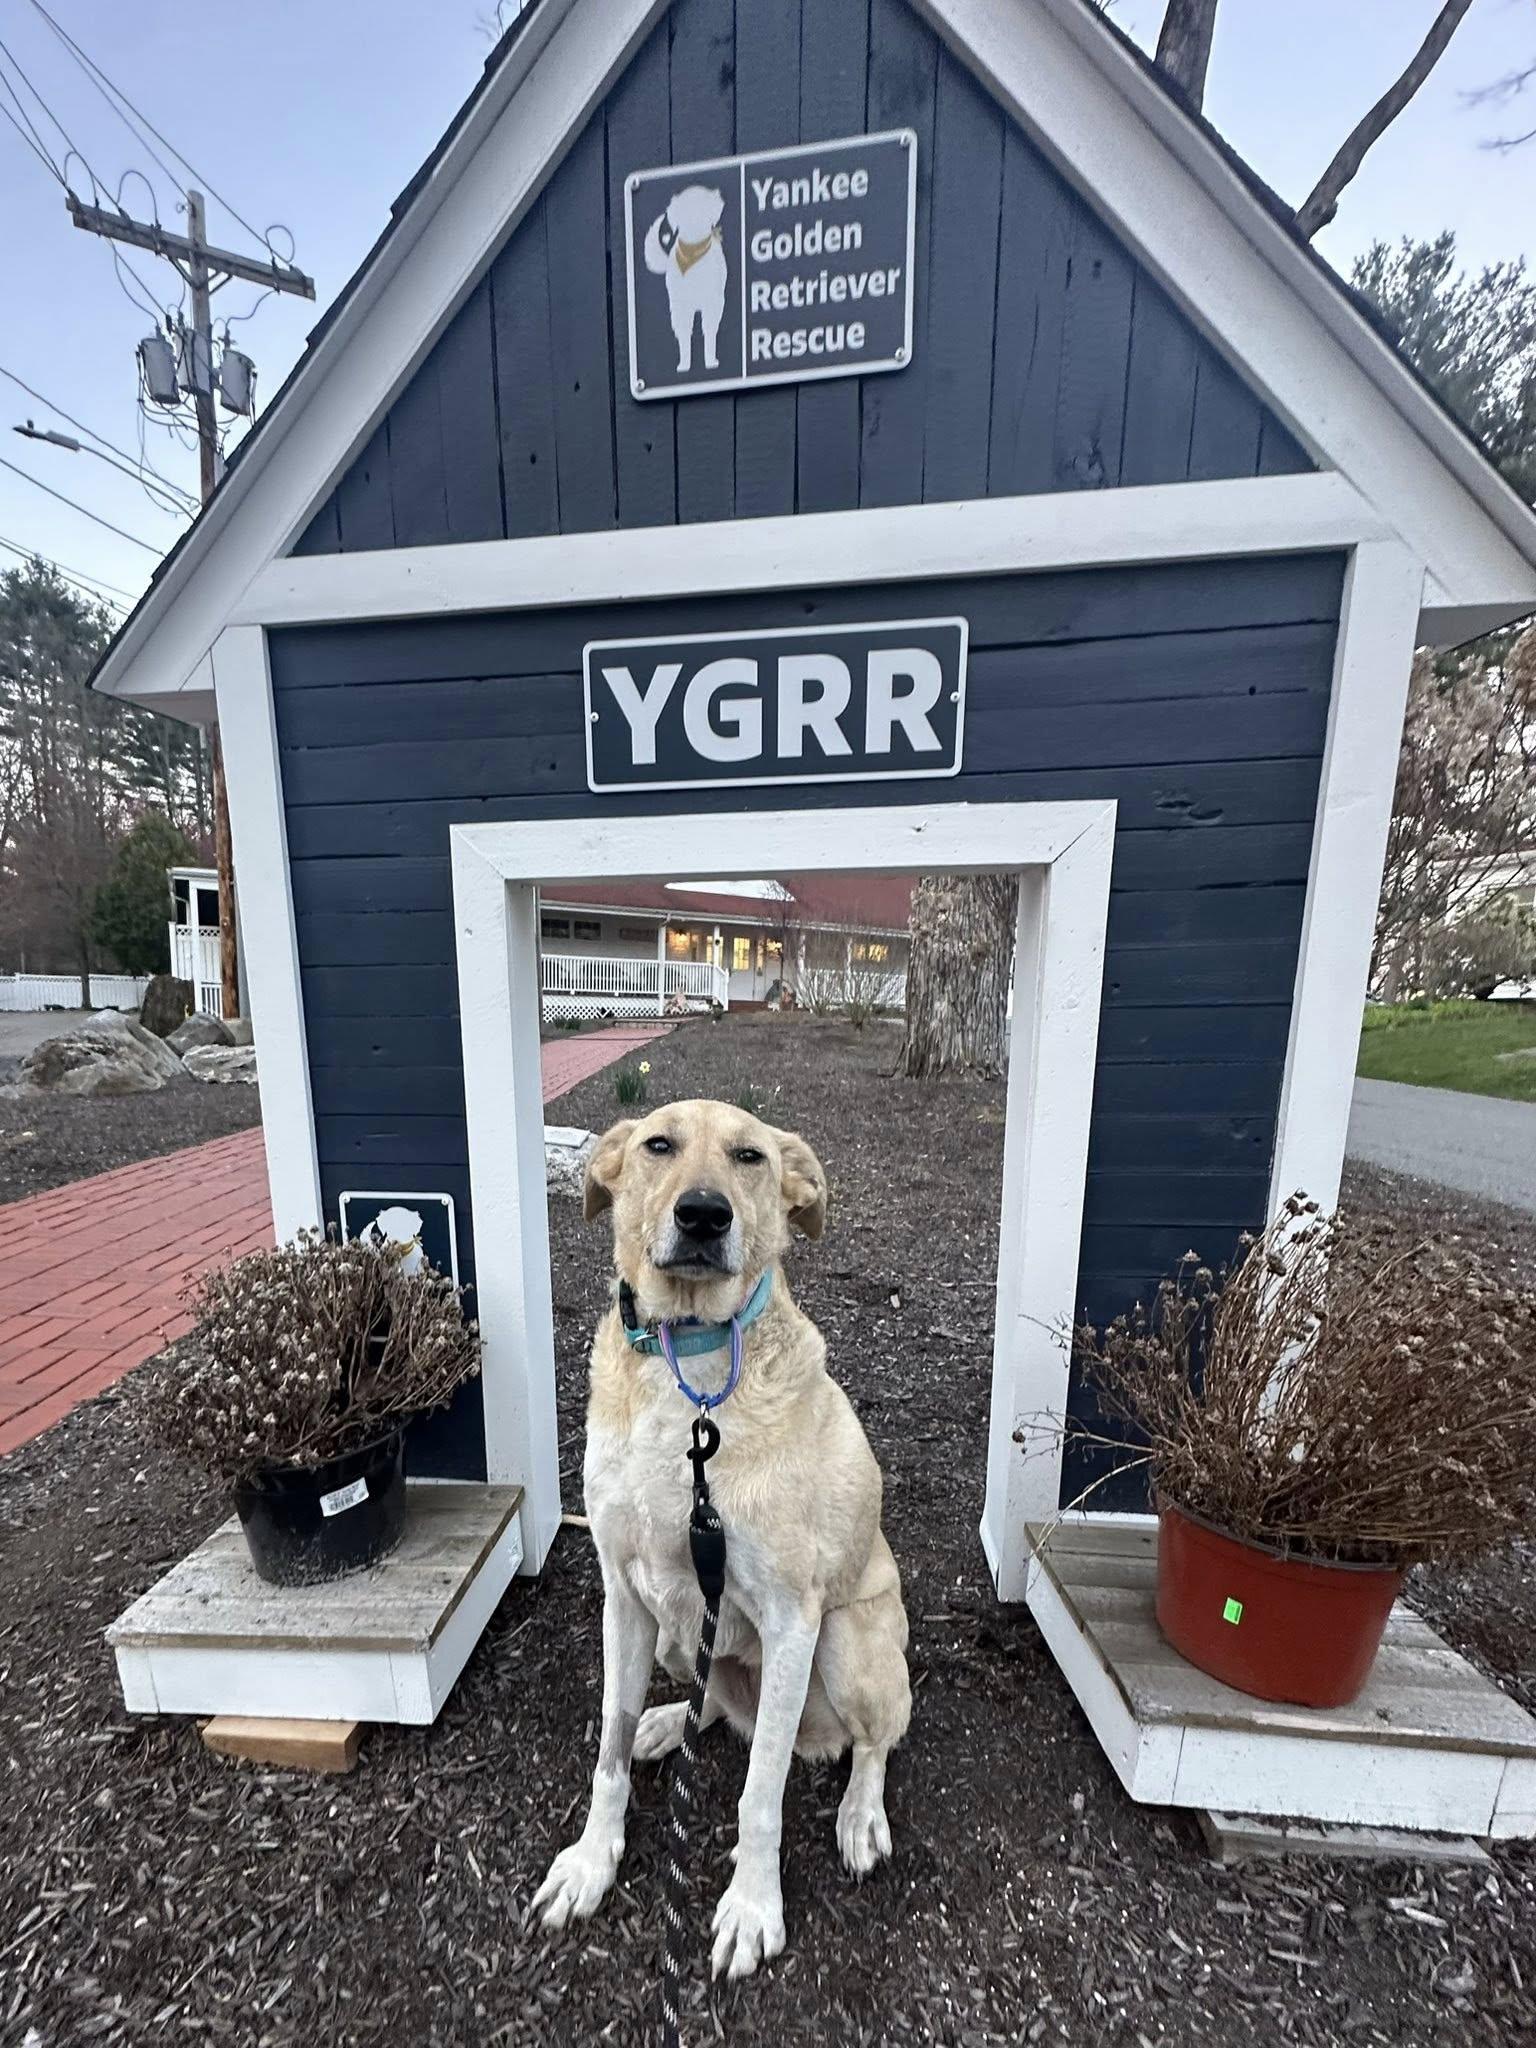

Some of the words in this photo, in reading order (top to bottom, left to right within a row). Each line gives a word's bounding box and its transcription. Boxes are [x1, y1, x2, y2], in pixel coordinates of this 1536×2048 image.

[752, 168, 868, 211] Yankee
[751, 219, 862, 262] Golden
[751, 267, 900, 313] Retriever
[751, 321, 865, 361] Rescue
[601, 647, 943, 765] YGRR
